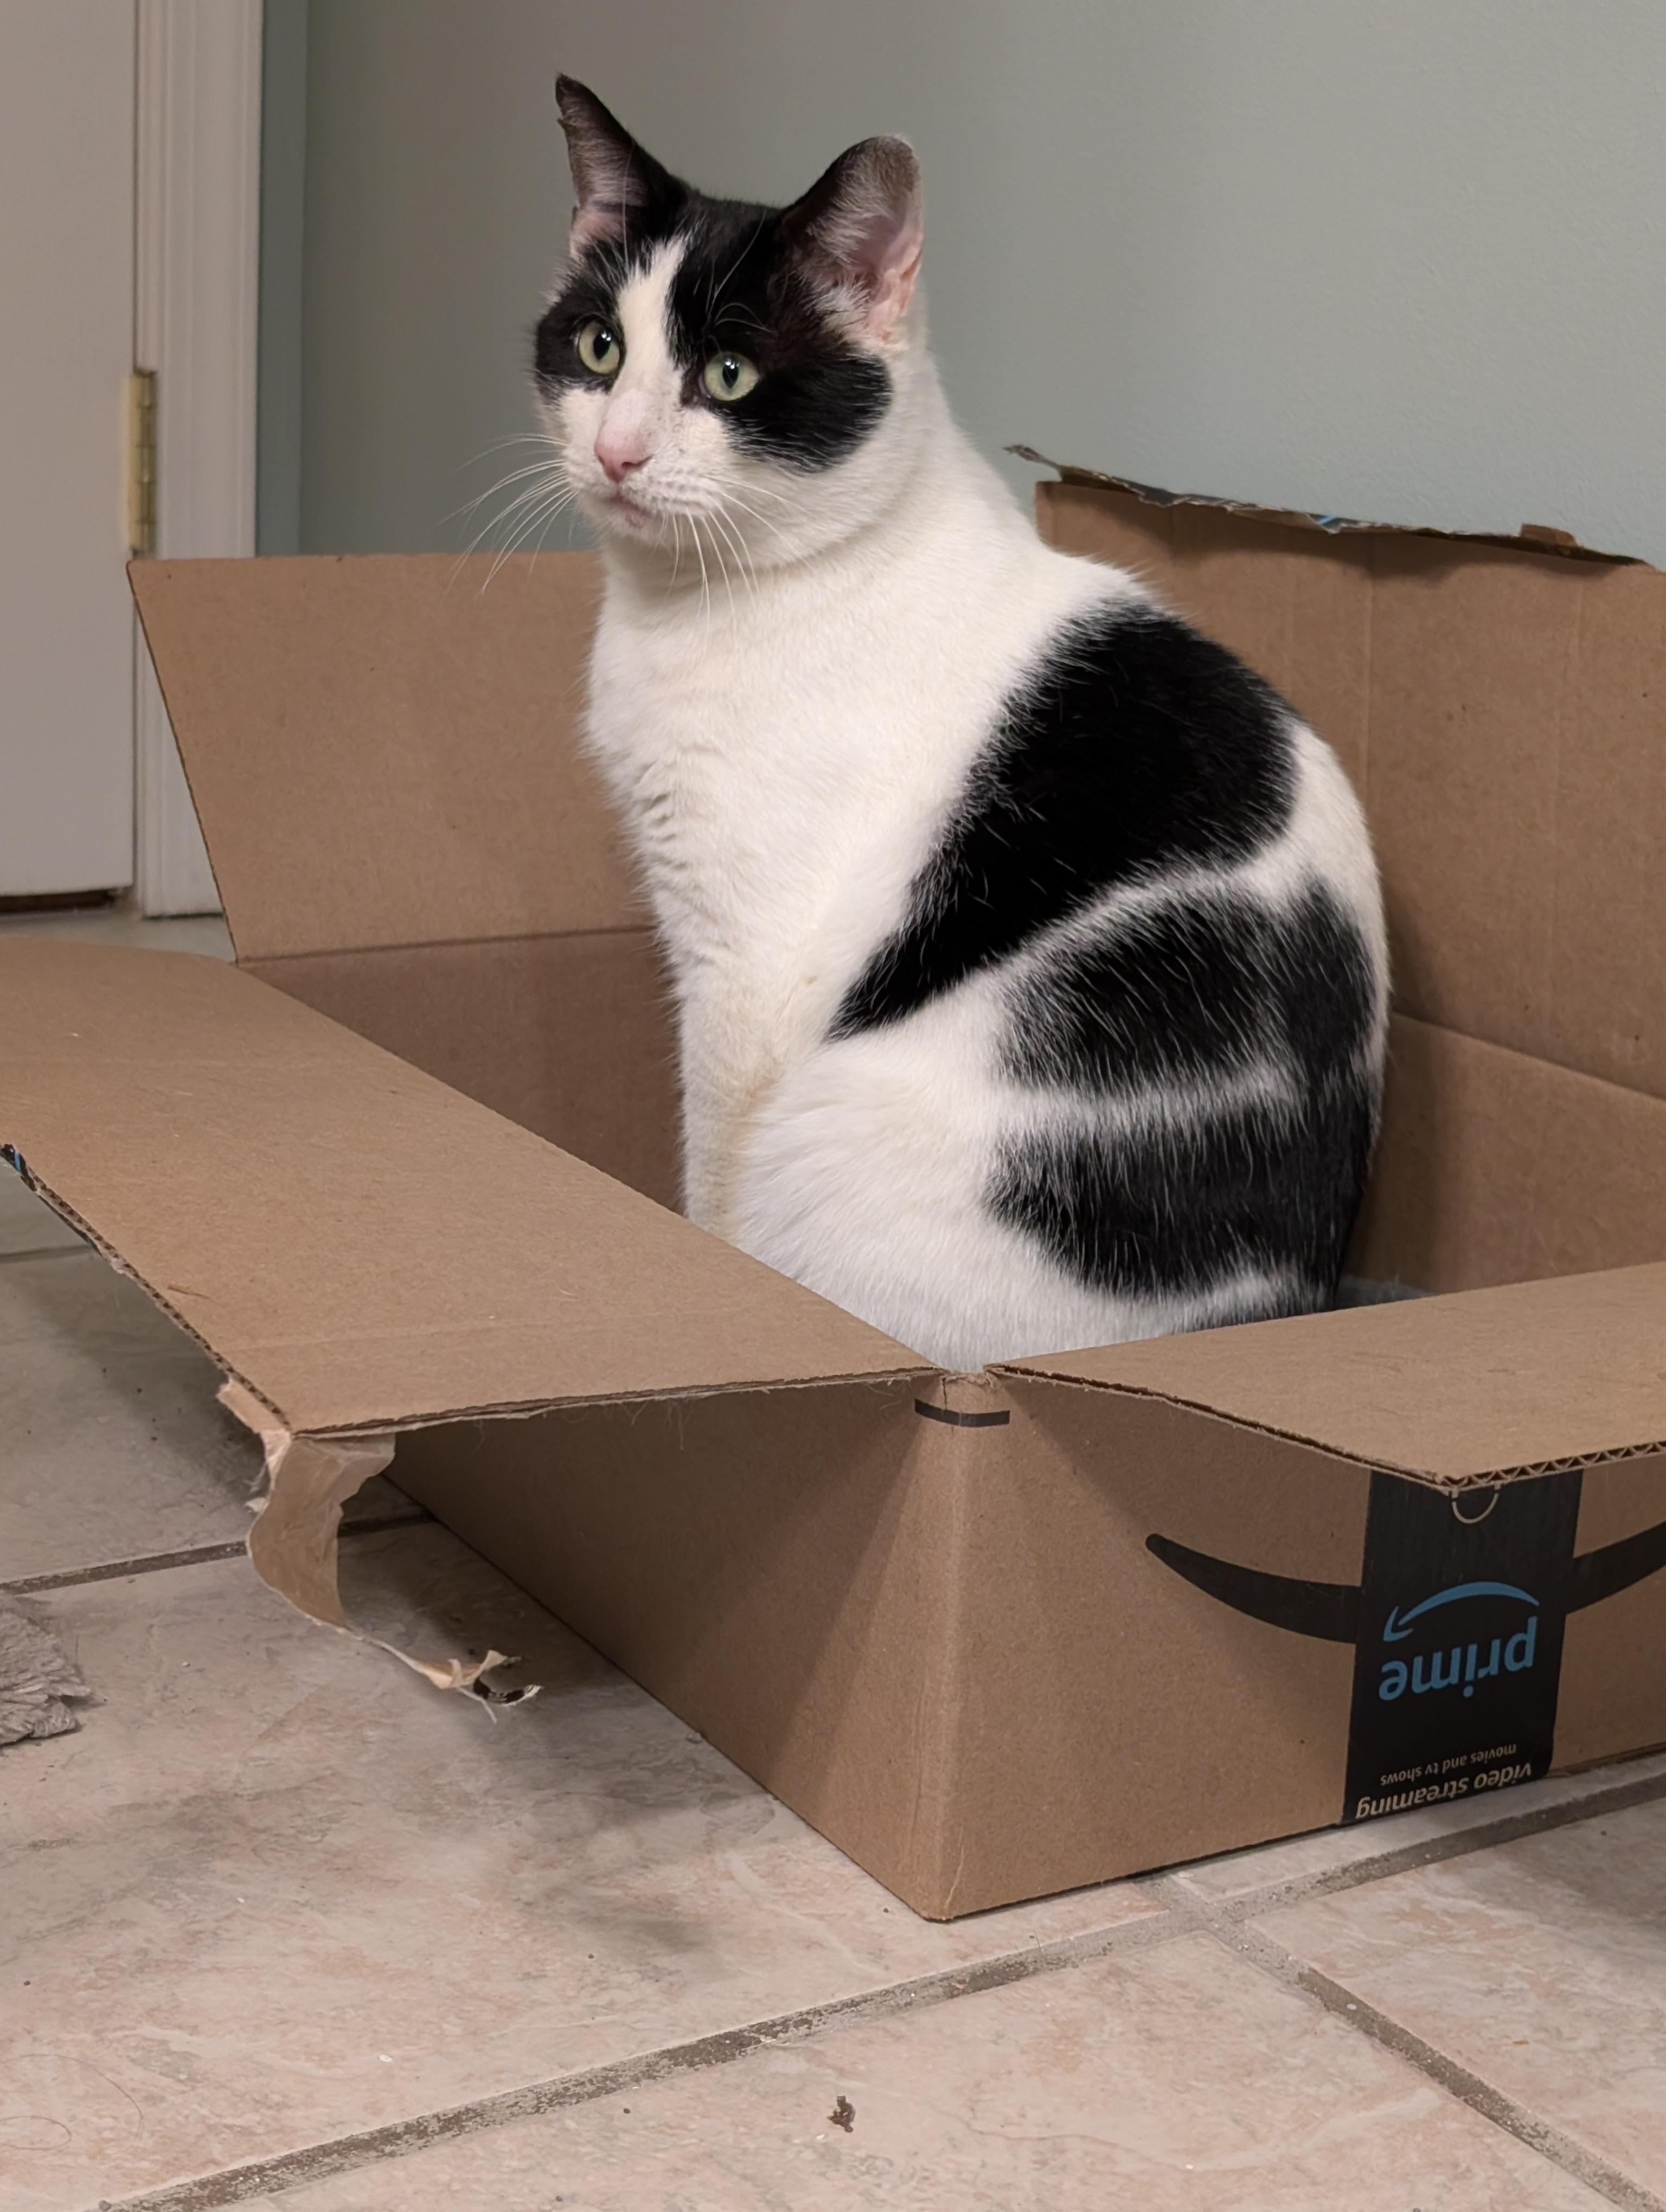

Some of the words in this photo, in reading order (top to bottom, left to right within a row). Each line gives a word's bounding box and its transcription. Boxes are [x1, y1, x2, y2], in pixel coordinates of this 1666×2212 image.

[1378, 1616, 1538, 1701] prime
[1470, 1743, 1516, 1764] movies
[1425, 1762, 1439, 1776] tv
[1442, 1755, 1468, 1774] and
[1380, 1766, 1422, 1786] shows
[1474, 1763, 1532, 1789] video
[1355, 1777, 1469, 1819] streaming
